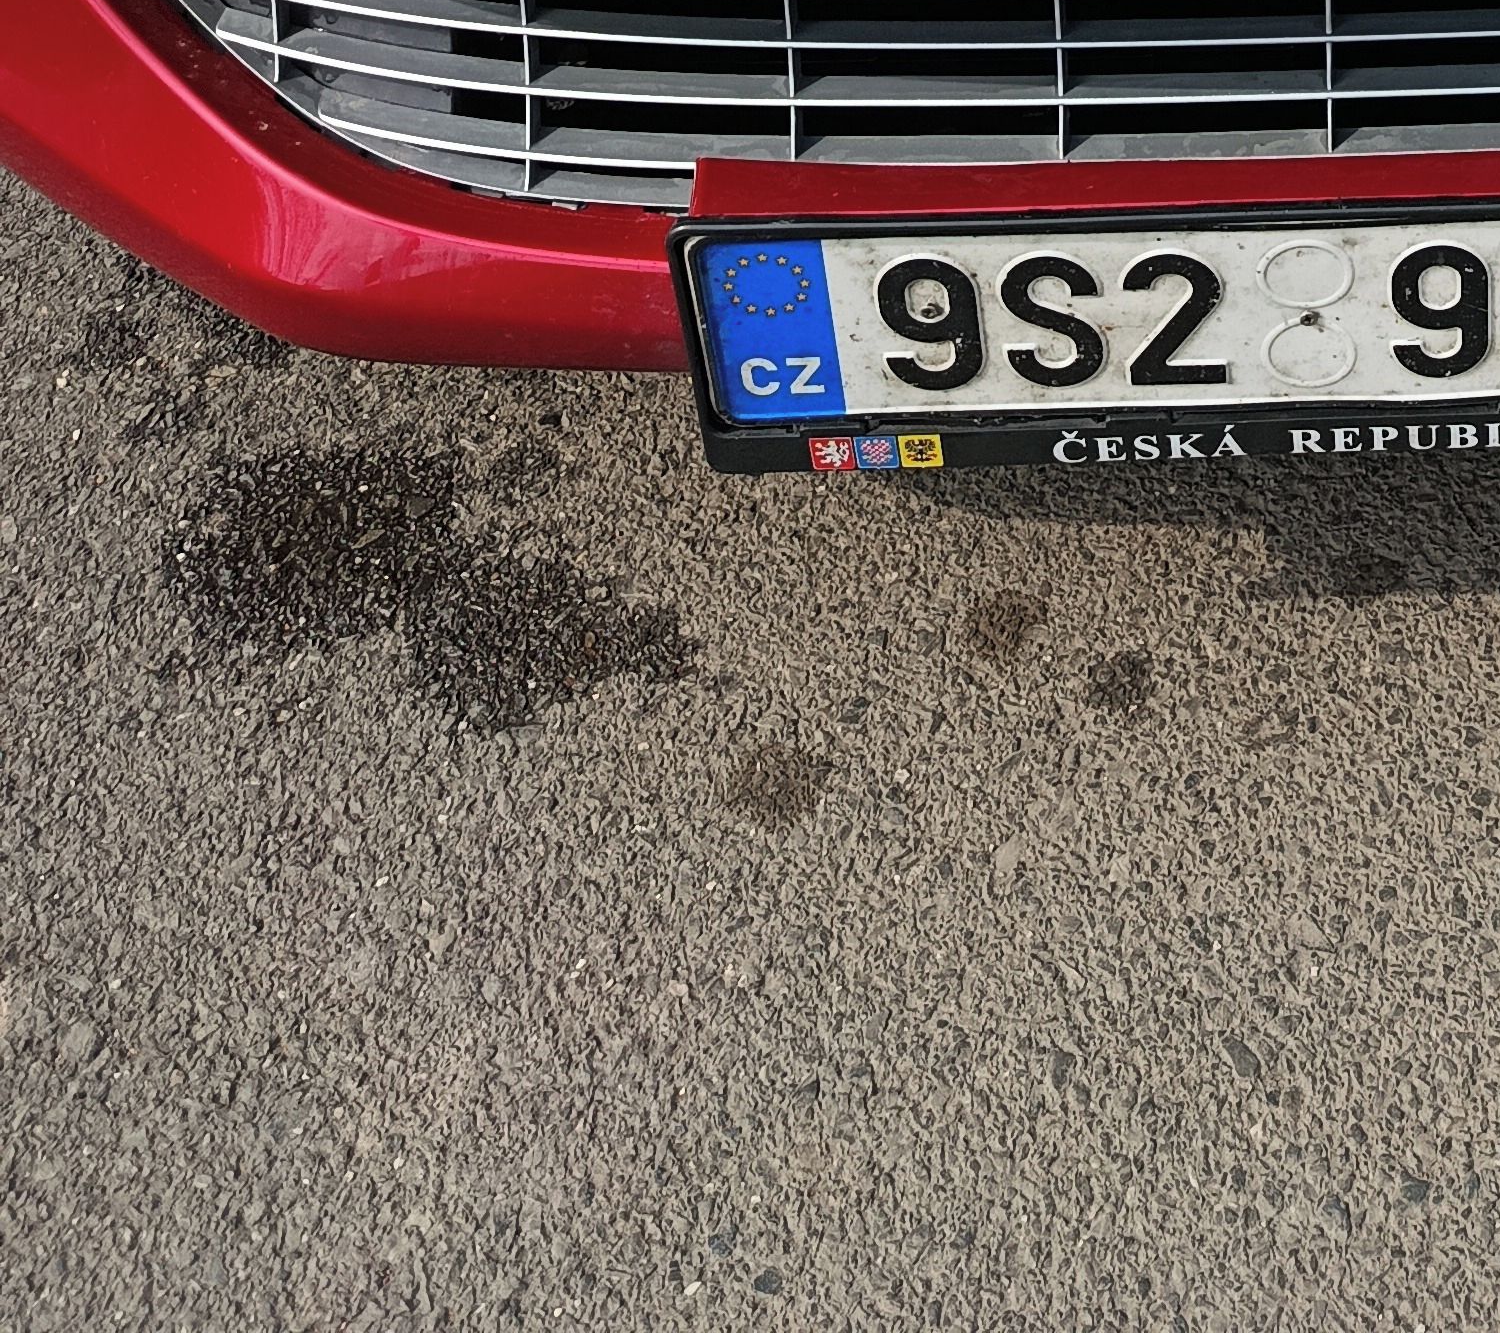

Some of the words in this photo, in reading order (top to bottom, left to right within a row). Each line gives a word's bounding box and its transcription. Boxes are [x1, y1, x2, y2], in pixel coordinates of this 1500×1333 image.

[877, 252, 1228, 391] 9S2
[740, 356, 826, 396] CZ
[1052, 423, 1248, 464] ČESKÁ
